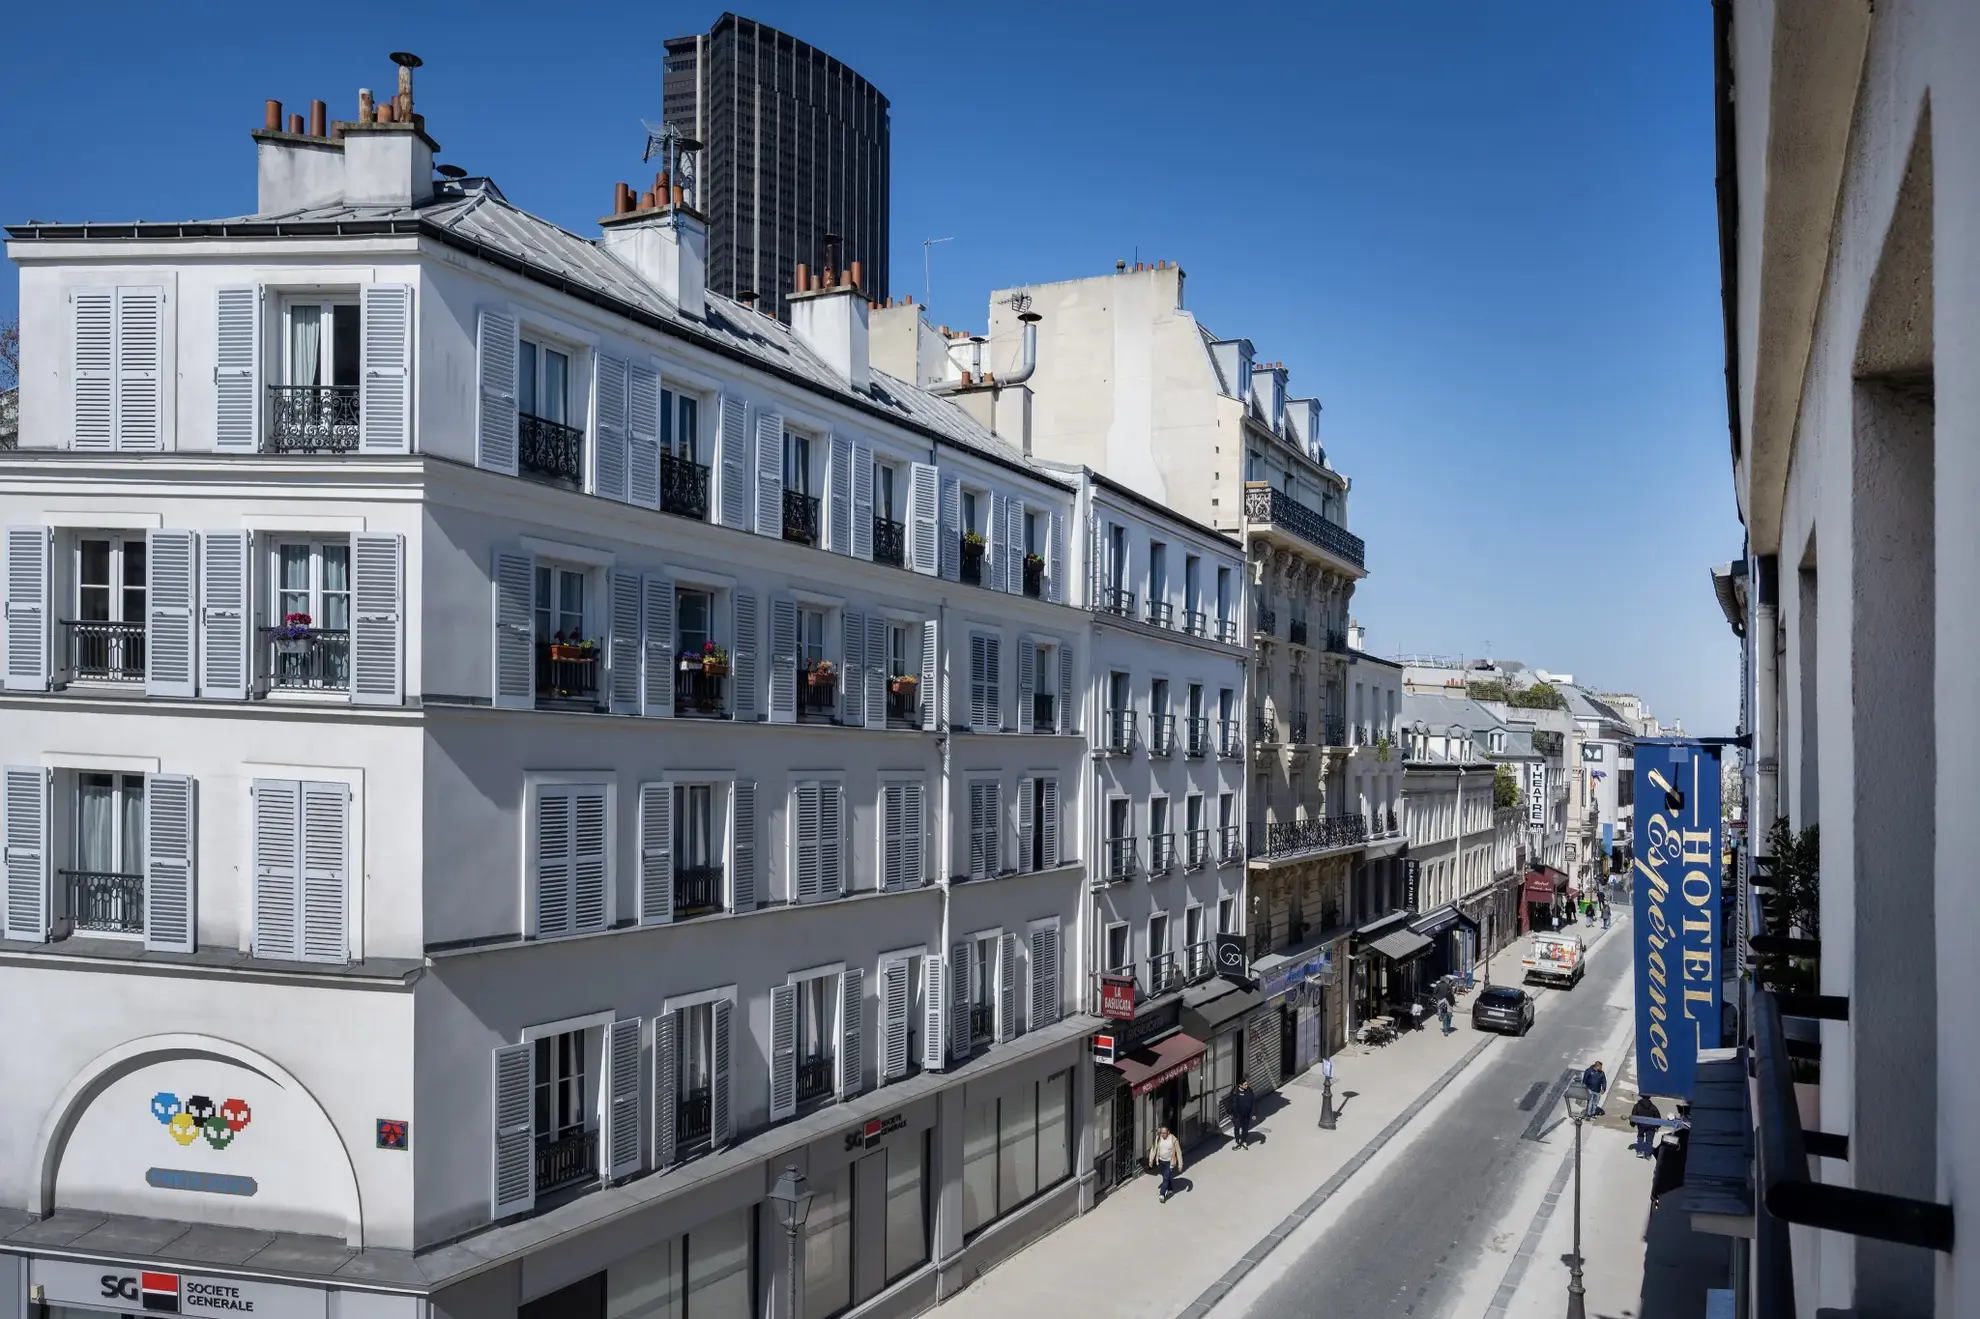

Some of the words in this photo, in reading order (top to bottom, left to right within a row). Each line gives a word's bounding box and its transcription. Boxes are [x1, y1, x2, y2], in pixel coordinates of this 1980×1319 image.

[1532, 763, 1542, 820] THEATRE
[1683, 827, 1713, 1020] HOTEL
[1114, 986, 1121, 998] LA
[1105, 997, 1132, 1011] BASILICATA
[844, 1129, 863, 1152] SG
[100, 1275, 139, 1301] SG
[187, 1282, 240, 1298] SOCIETE
[187, 1295, 254, 1311] GENERALE
